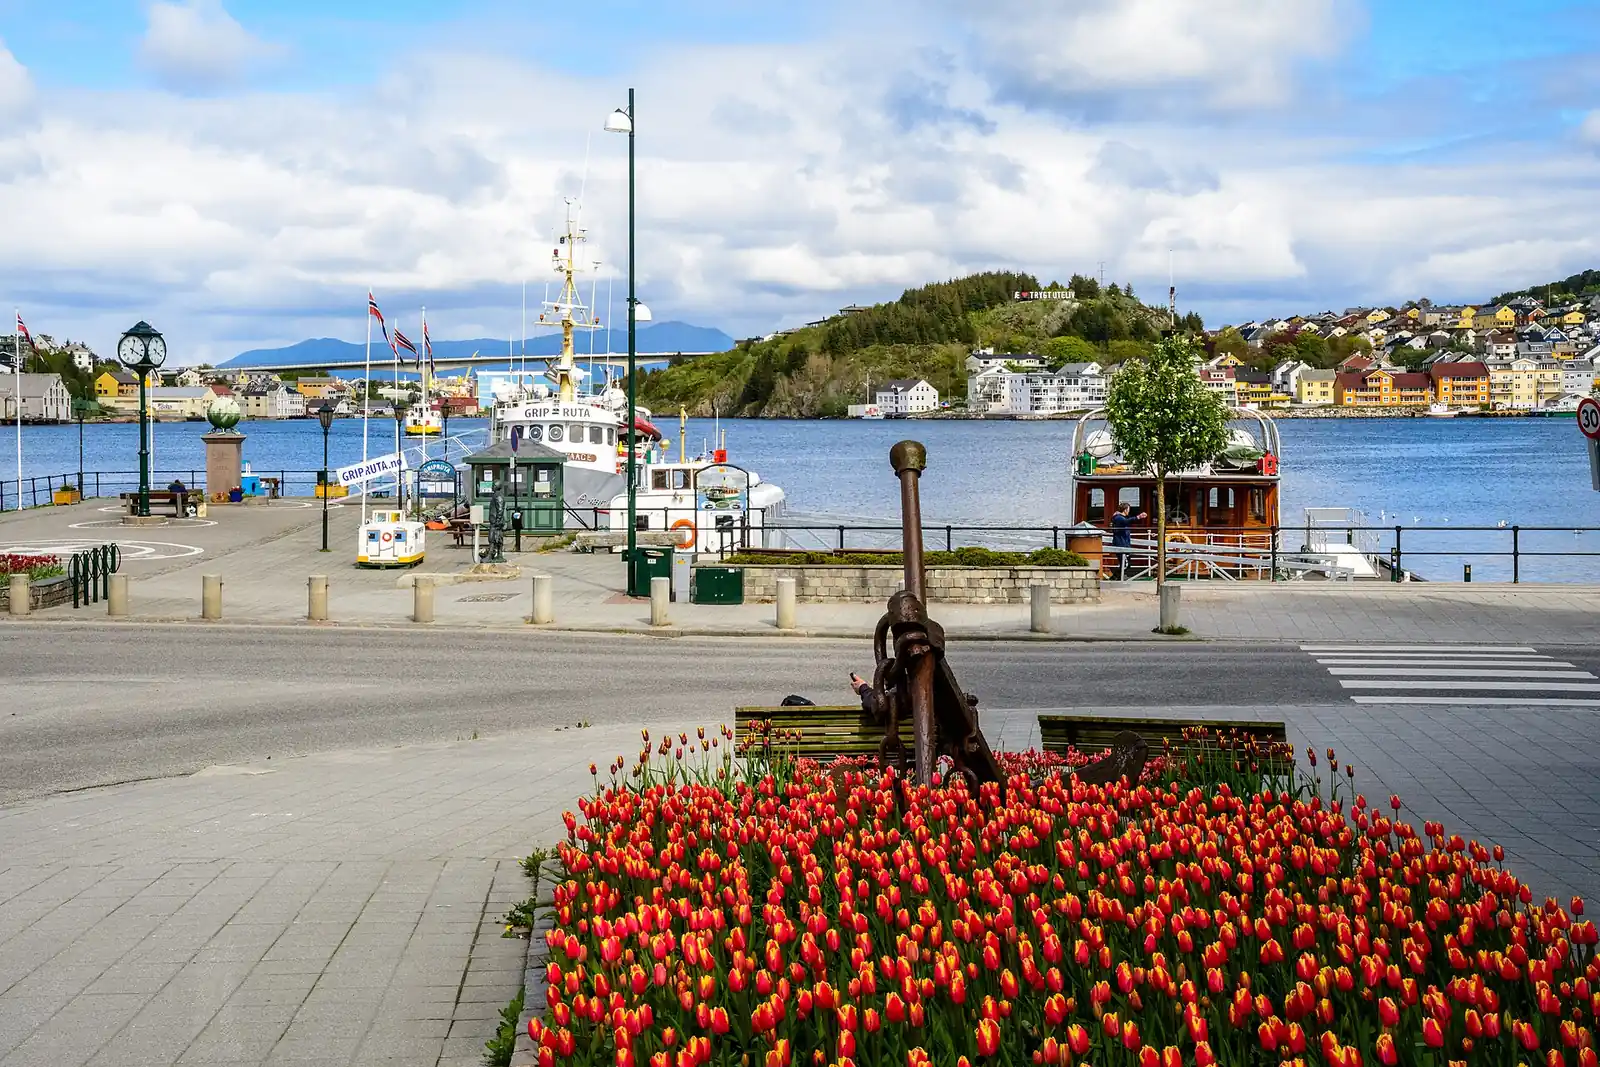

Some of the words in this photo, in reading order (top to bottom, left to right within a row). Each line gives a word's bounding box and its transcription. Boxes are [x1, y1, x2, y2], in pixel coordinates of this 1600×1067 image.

[525, 408, 549, 418] GRIP
[563, 408, 590, 418] RUTA
[1582, 409, 1598, 428] 30
